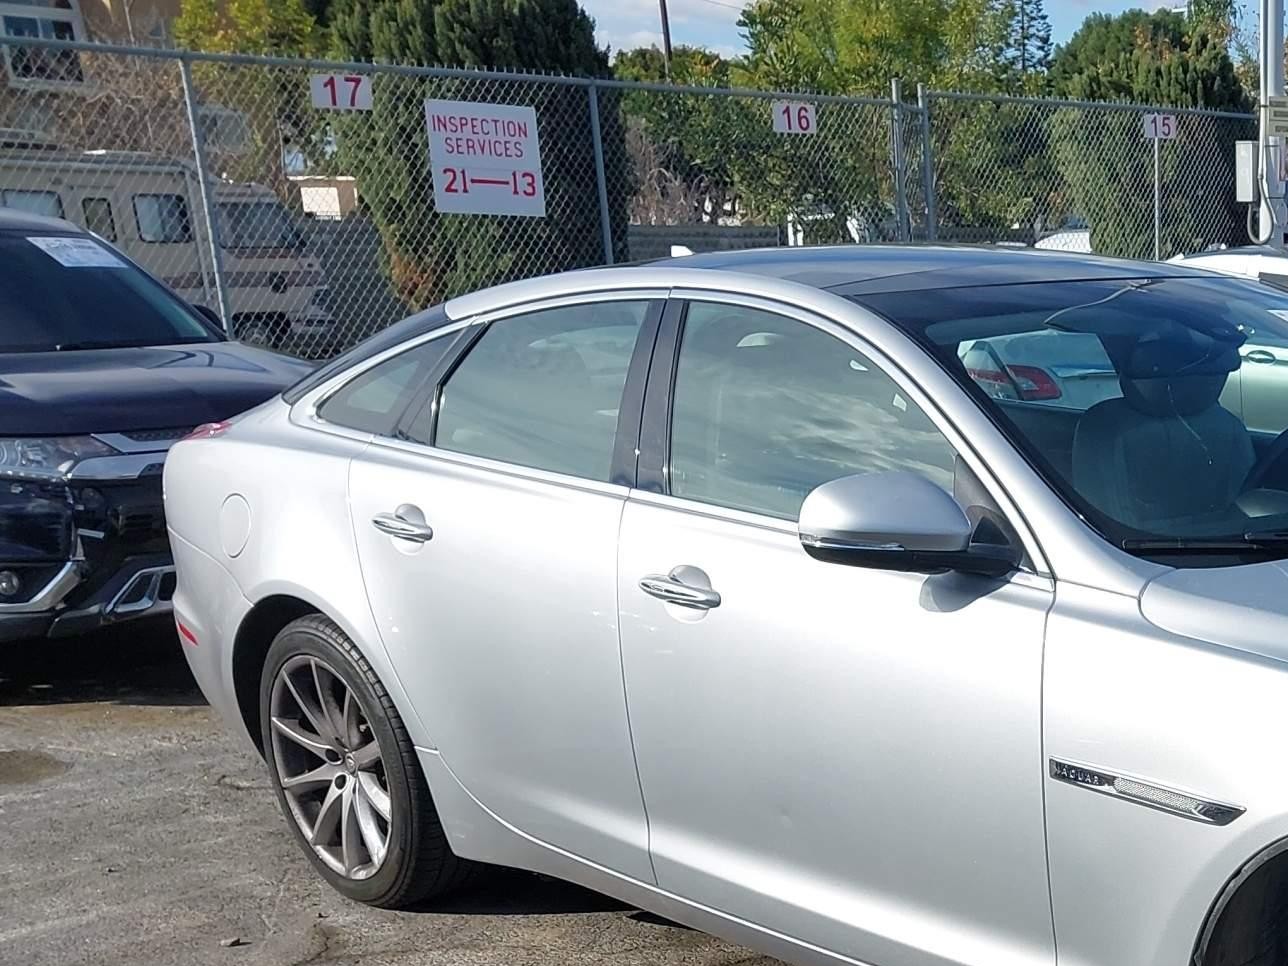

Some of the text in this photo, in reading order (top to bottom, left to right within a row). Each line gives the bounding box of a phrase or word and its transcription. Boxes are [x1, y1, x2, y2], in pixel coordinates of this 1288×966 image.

[323, 76, 362, 107] 17
[431, 114, 528, 138] INSPECTION
[782, 105, 810, 131] 16
[1151, 115, 1171, 137] 15
[444, 138, 524, 158] SERVICES
